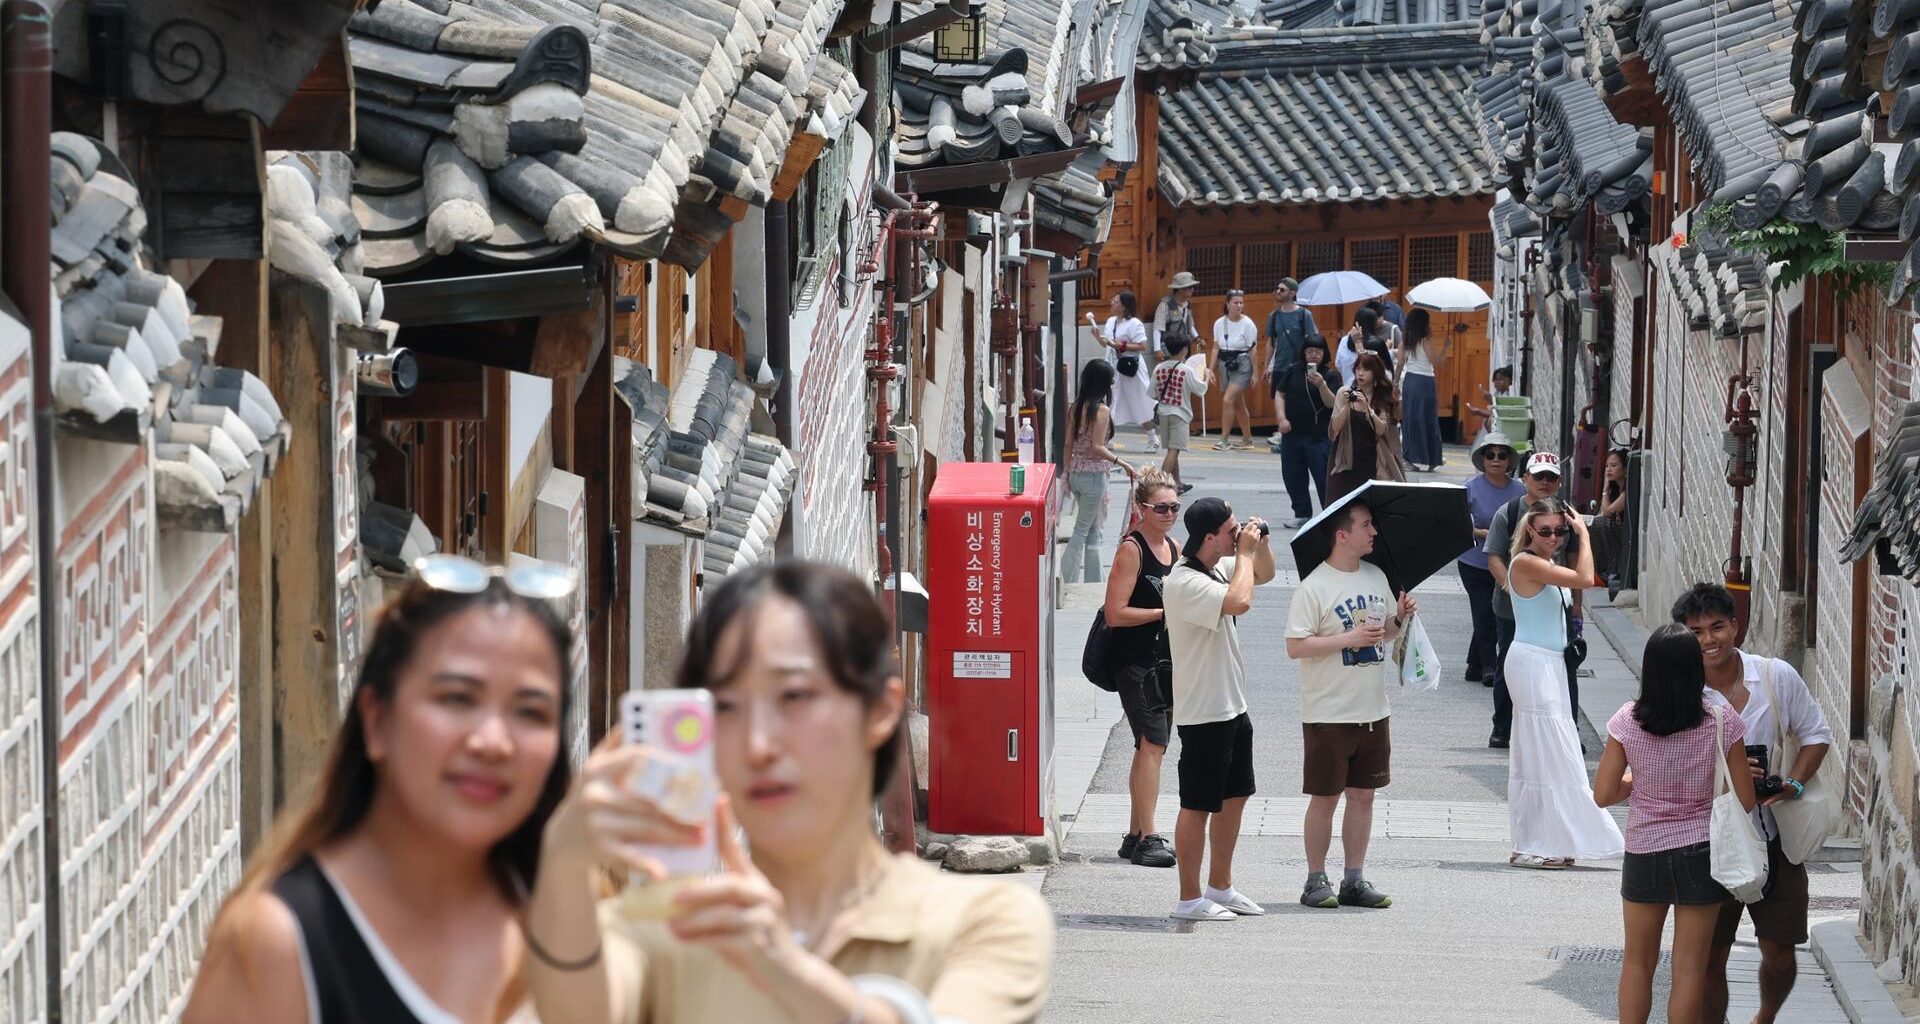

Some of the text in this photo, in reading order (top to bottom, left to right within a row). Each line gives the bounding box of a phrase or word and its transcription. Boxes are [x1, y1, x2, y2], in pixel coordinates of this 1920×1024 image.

[1534, 453, 1558, 465] NYC
[966, 511, 984, 636] 비상소화장치
[991, 512, 1003, 635] Emergency Fire Hydrant
